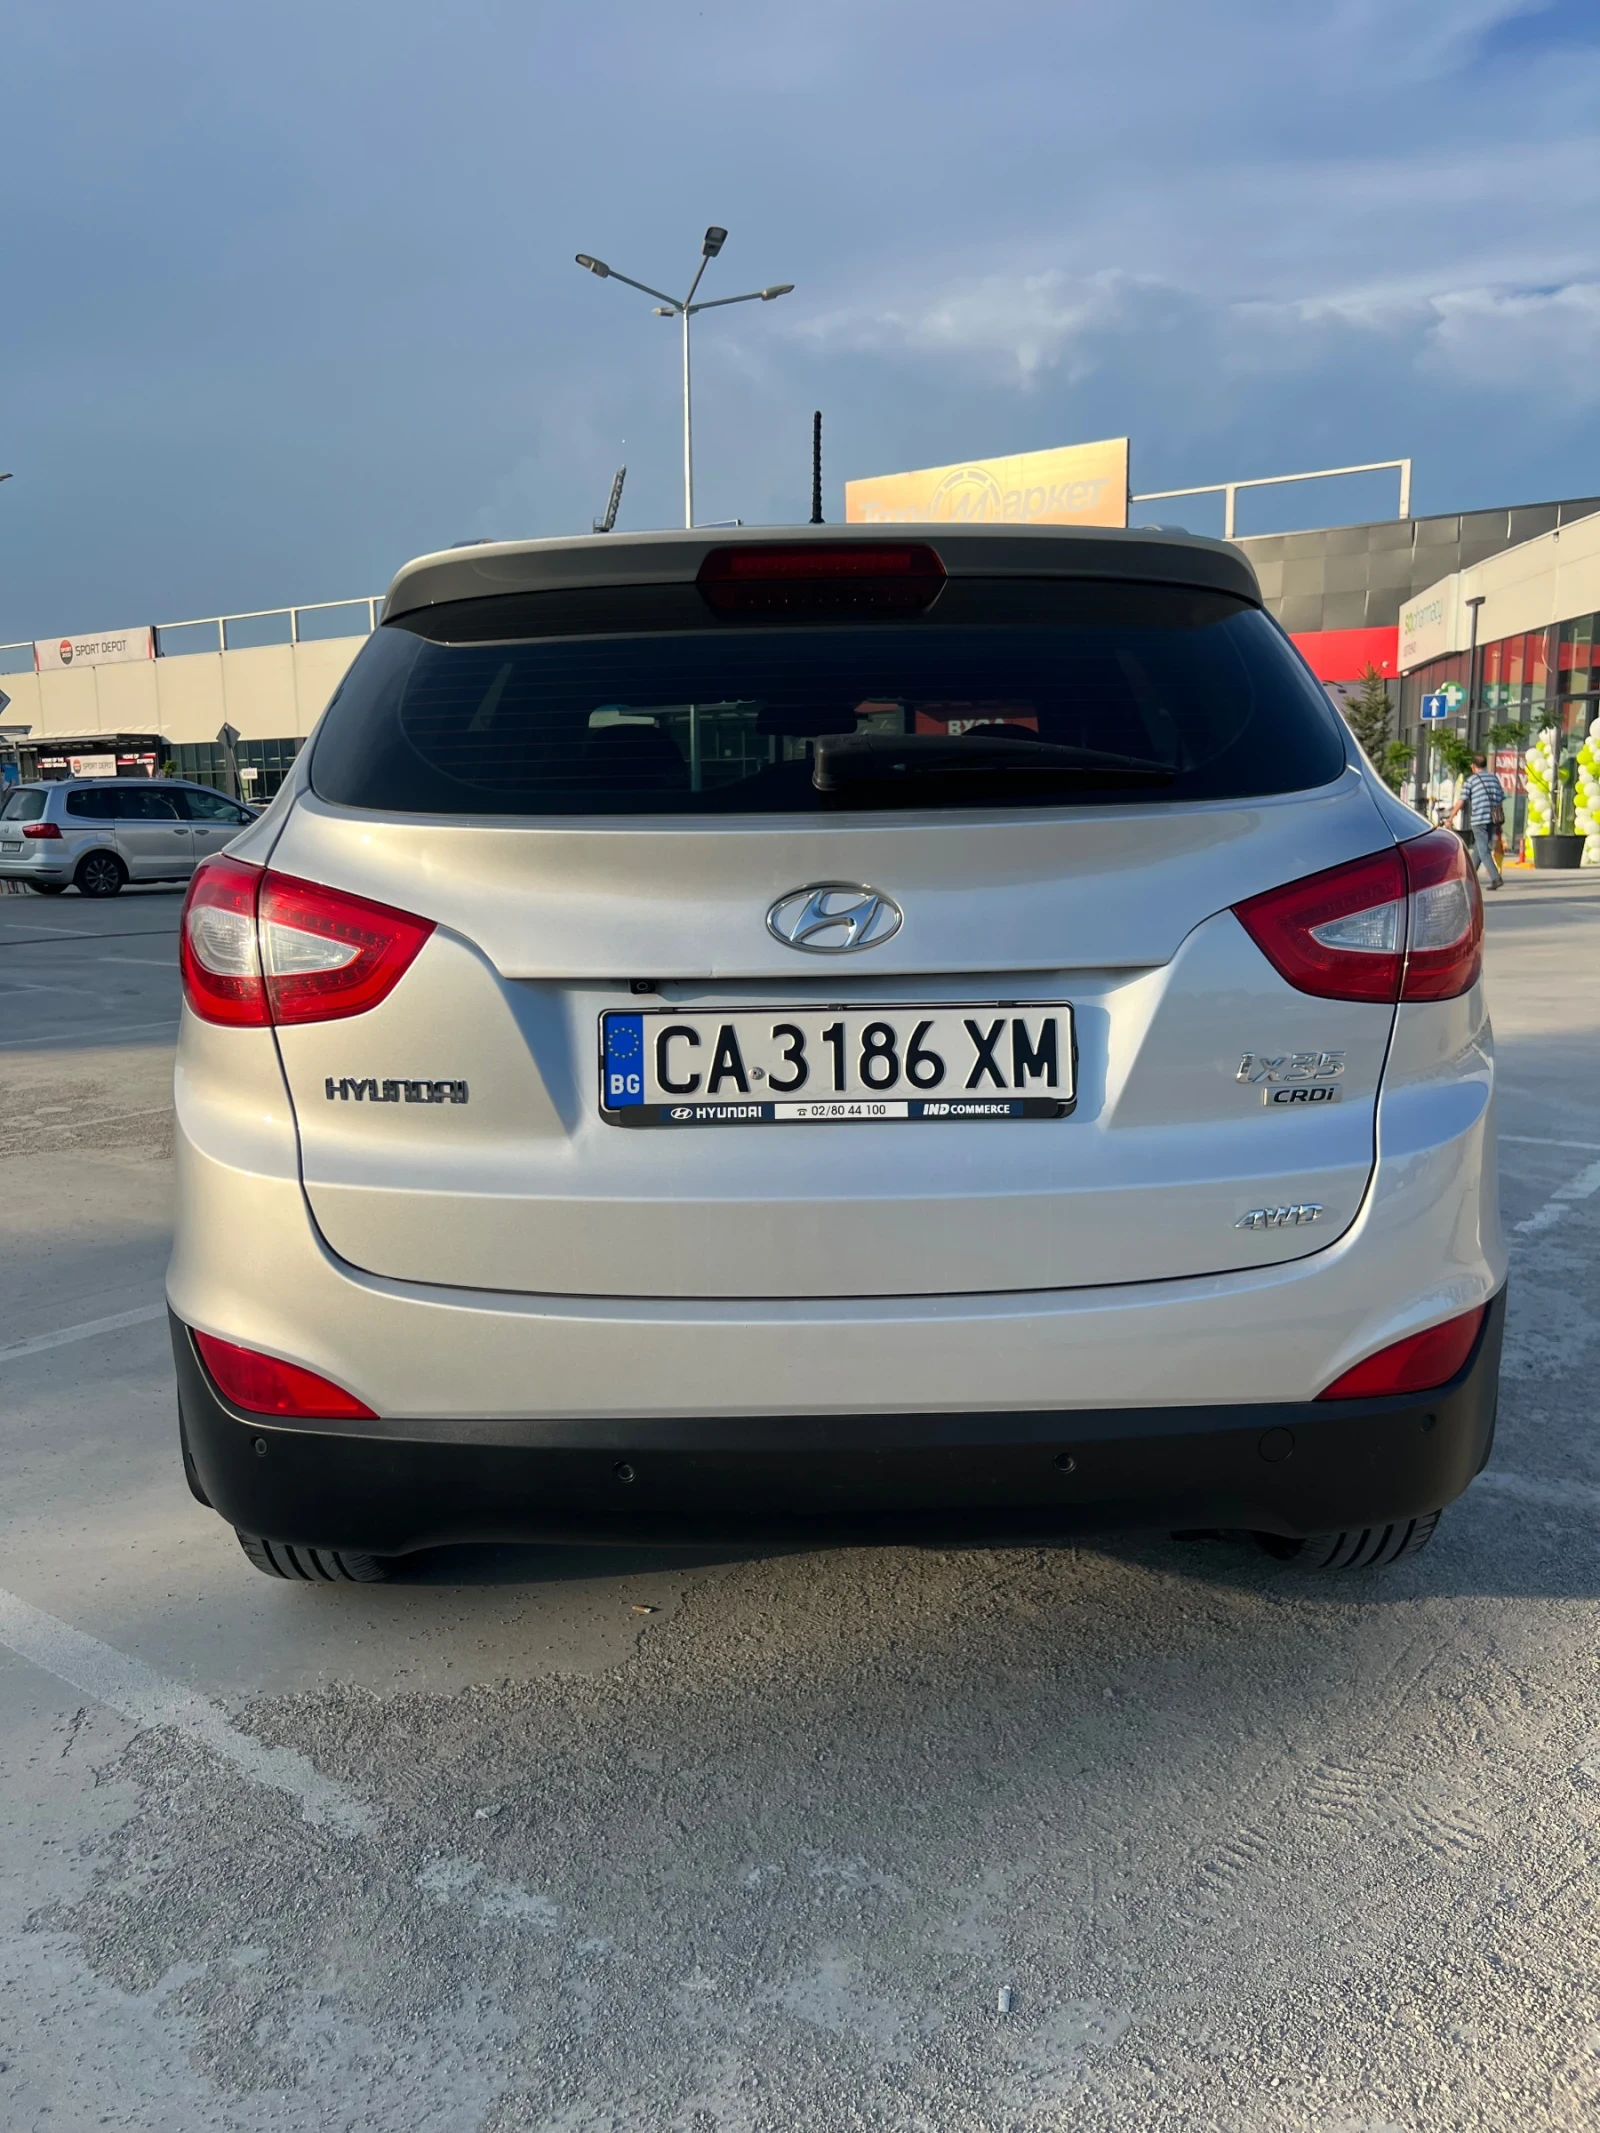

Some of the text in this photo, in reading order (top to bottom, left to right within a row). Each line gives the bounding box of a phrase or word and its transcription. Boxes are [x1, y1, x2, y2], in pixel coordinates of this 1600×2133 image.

[75, 640, 127, 656] SPORT DEPOT
[83, 762, 98, 770] SPORT
[98, 761, 114, 769] DEPOT
[655, 1018, 1057, 1093] CA 3186 XM
[325, 1077, 469, 1104] HYUNDAI
[611, 1073, 641, 1094] BG
[1273, 1087, 1335, 1103] CRDi
[696, 1106, 762, 1119] HYUNDAI
[811, 1104, 886, 1117] 02/80 44 100
[950, 1104, 1010, 1115] COMMERCE
[1234, 1203, 1323, 1230] 4WD
